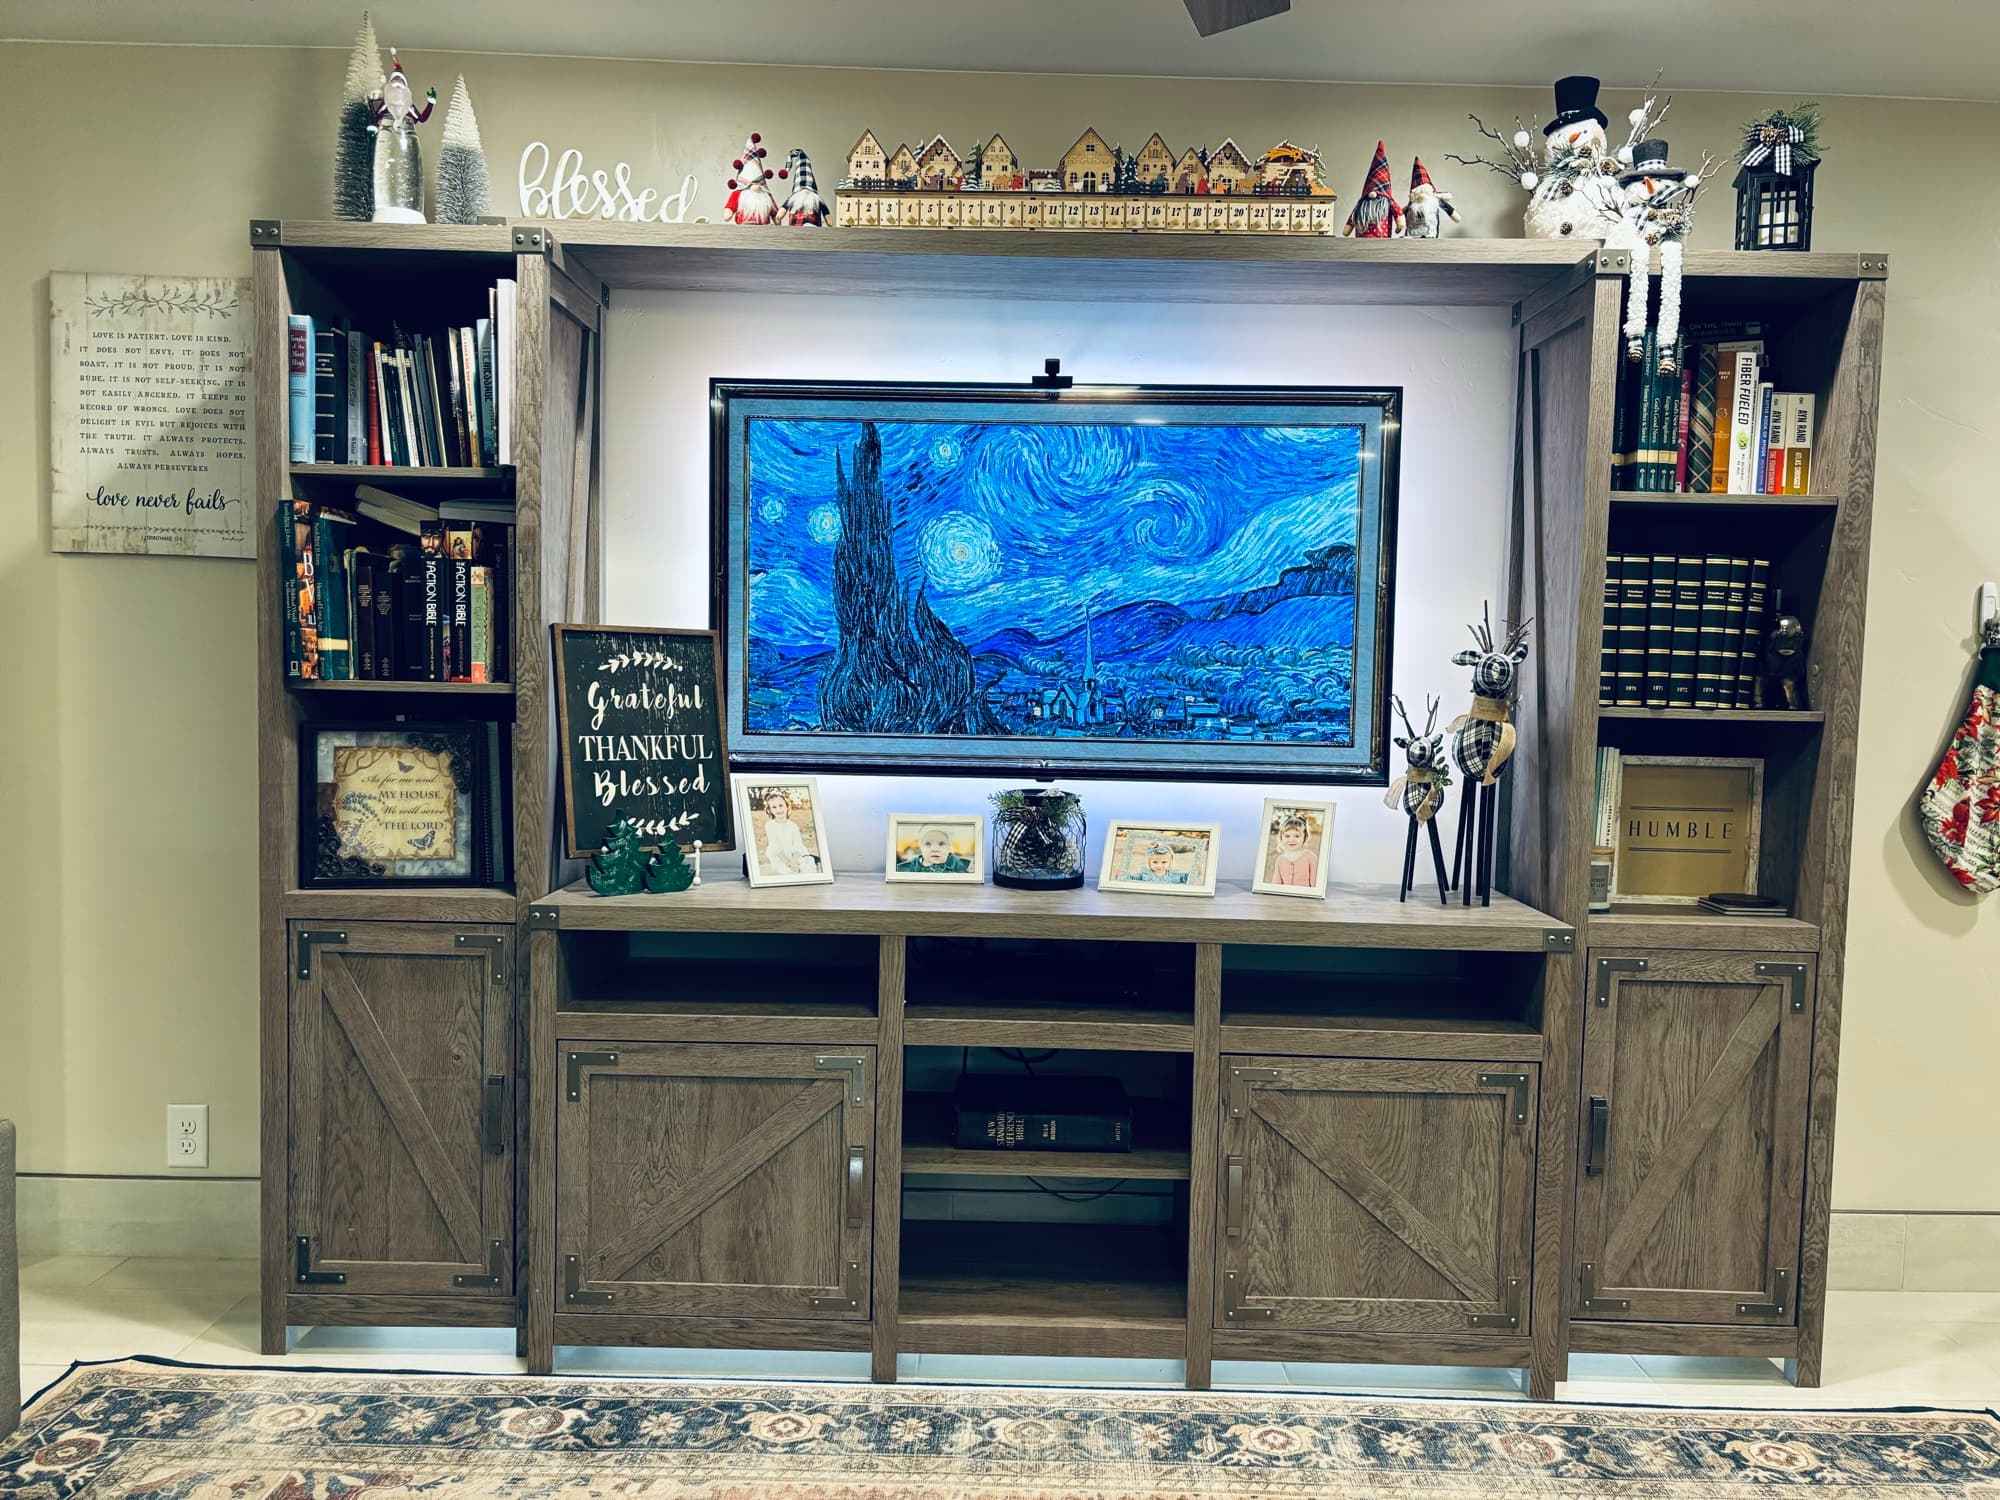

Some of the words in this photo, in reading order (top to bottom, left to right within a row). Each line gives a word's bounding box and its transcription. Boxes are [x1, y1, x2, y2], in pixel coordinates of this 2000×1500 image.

[519, 141, 709, 224] blessed
[845, 203, 852, 212] 1
[866, 203, 872, 213] 2
[886, 203, 893, 213] 3
[907, 203, 913, 213] 4
[927, 204, 934, 213] 5
[947, 204, 953, 213] 6
[968, 204, 974, 214] 7
[988, 205, 995, 214] 8
[1009, 205, 1015, 214] 9
[1028, 205, 1038, 215] 10
[1049, 205, 1057, 215] 11
[1068, 206, 1079, 215] 12
[1089, 207, 1099, 215] 13
[1110, 207, 1120, 216] 14
[1131, 207, 1141, 216] 15
[1152, 207, 1161, 216] 16
[1171, 207, 1181, 217] 17
[1193, 208, 1202, 217] 18
[1213, 208, 1223, 217] 19
[1233, 208, 1244, 217] 20
[1254, 208, 1265, 217] 21
[1274, 208, 1286, 217] 22
[1295, 209, 1306, 218] 23
[1316, 209, 1327, 218] 24
[1740, 357, 1753, 386] FIBER
[1738, 388, 1751, 425] FUELED
[1798, 409, 1808, 423] AYN
[181, 422, 218, 430] REJOICES
[1772, 410, 1782, 423] AYN
[160, 435, 194, 443] ALWAYS
[1771, 424, 1781, 444] RAND
[1796, 424, 1807, 443] RAND
[155, 464, 208, 472] PERSEVERES
[86, 486, 130, 508] love
[136, 494, 181, 509] never
[186, 487, 240, 515] fails
[426, 565, 437, 602] ACTION
[455, 566, 466, 603] ACTION
[426, 603, 437, 626] BIBLE
[455, 604, 466, 627] BIBLE
[587, 681, 704, 730] Grateful
[578, 735, 713, 761] THANKFUL
[361, 774, 379, 783] As
[378, 773, 397, 789] for
[593, 763, 710, 806] Blessed
[380, 790, 397, 799] MY
[383, 806, 397, 814] We
[399, 803, 430, 814] will
[381, 821, 407, 830] THE
[1629, 820, 1735, 839] HUMBLE
[987, 1120, 996, 1137] NEW
[1015, 1119, 1024, 1141] BIBLE
